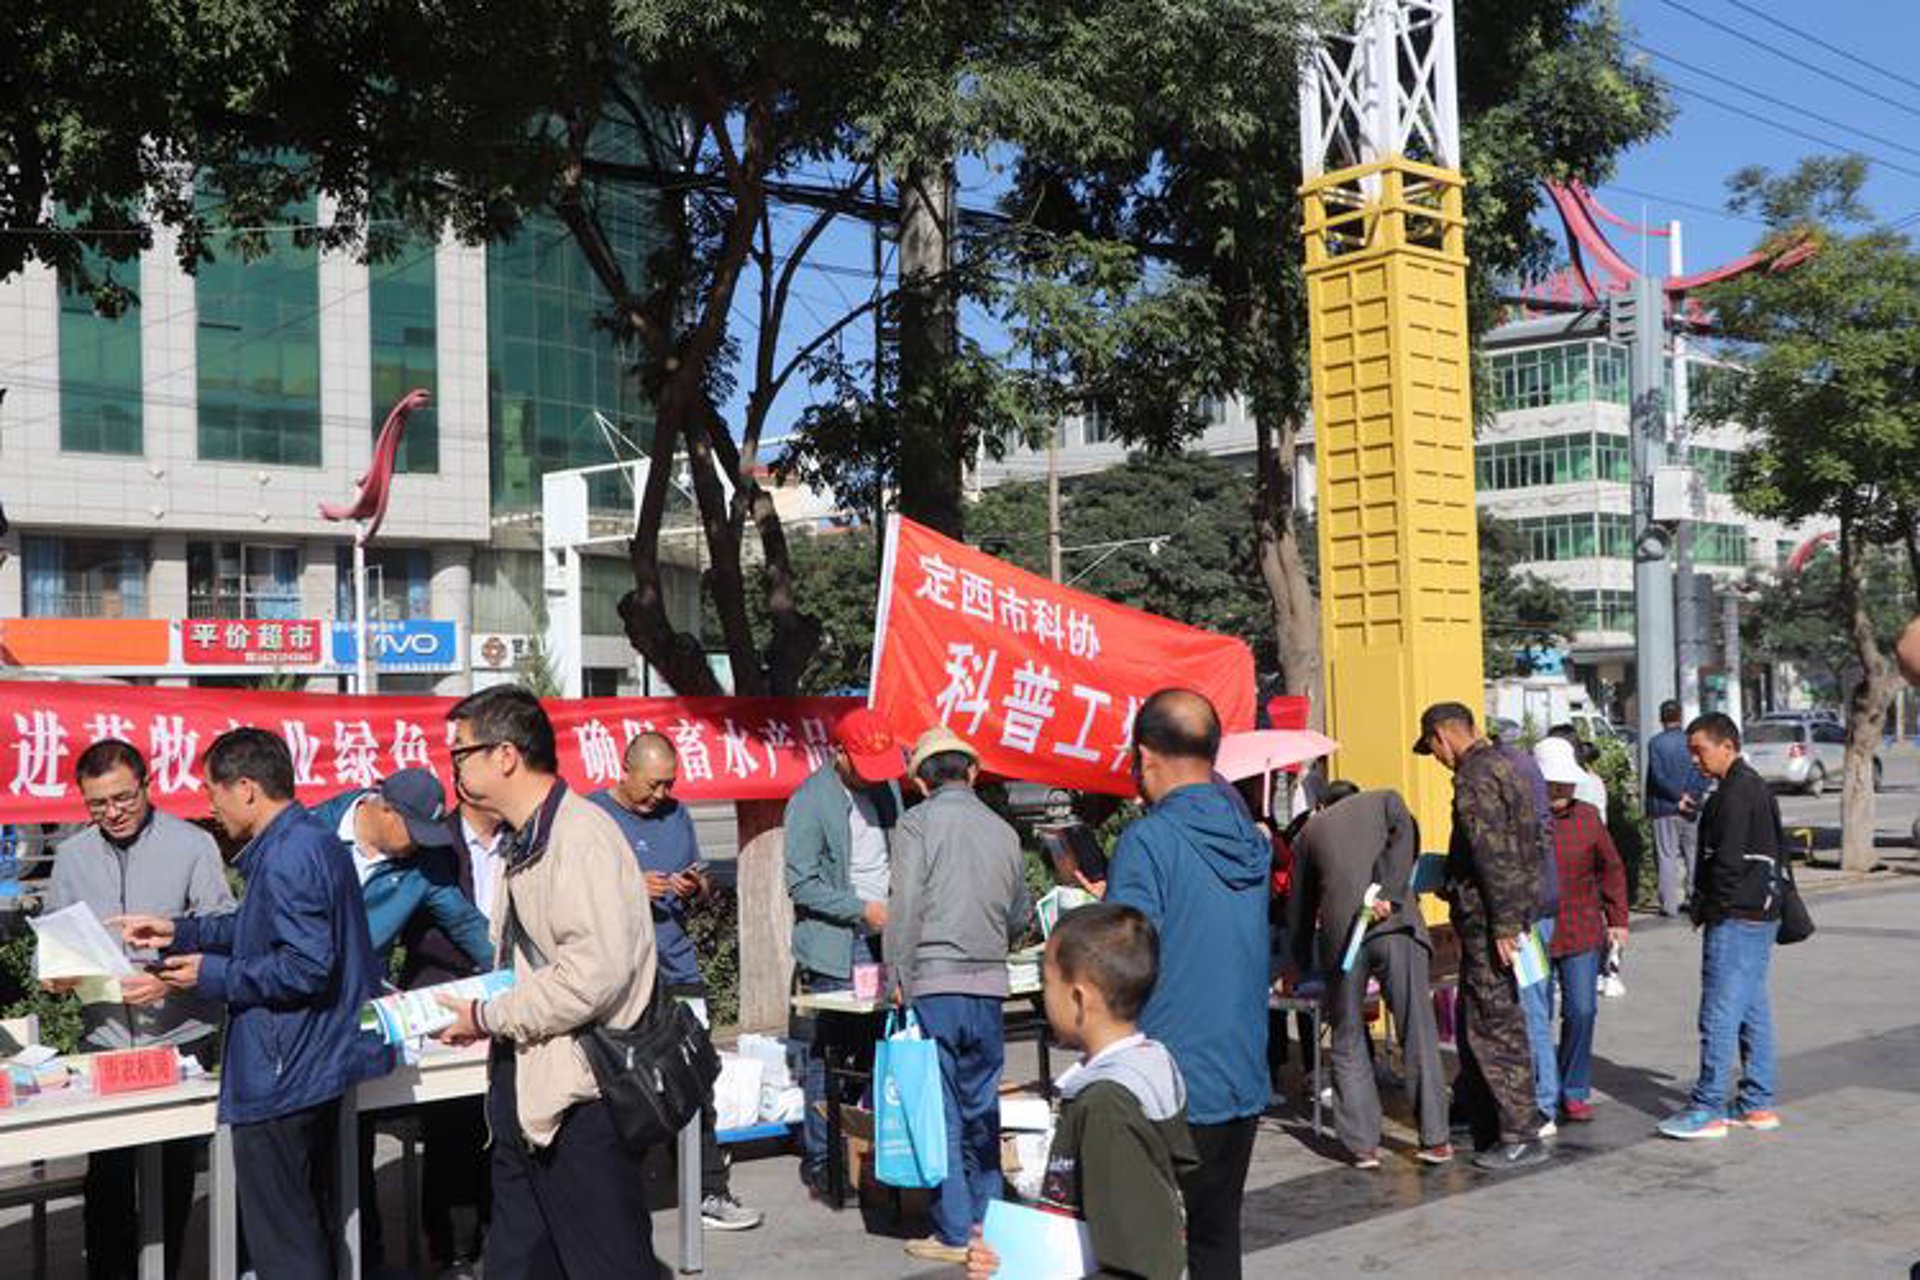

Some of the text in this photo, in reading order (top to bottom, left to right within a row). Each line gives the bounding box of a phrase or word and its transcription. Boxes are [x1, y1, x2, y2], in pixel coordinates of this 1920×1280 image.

[190, 623, 313, 649] 平价超市
[915, 553, 1102, 660] 定西市科协
